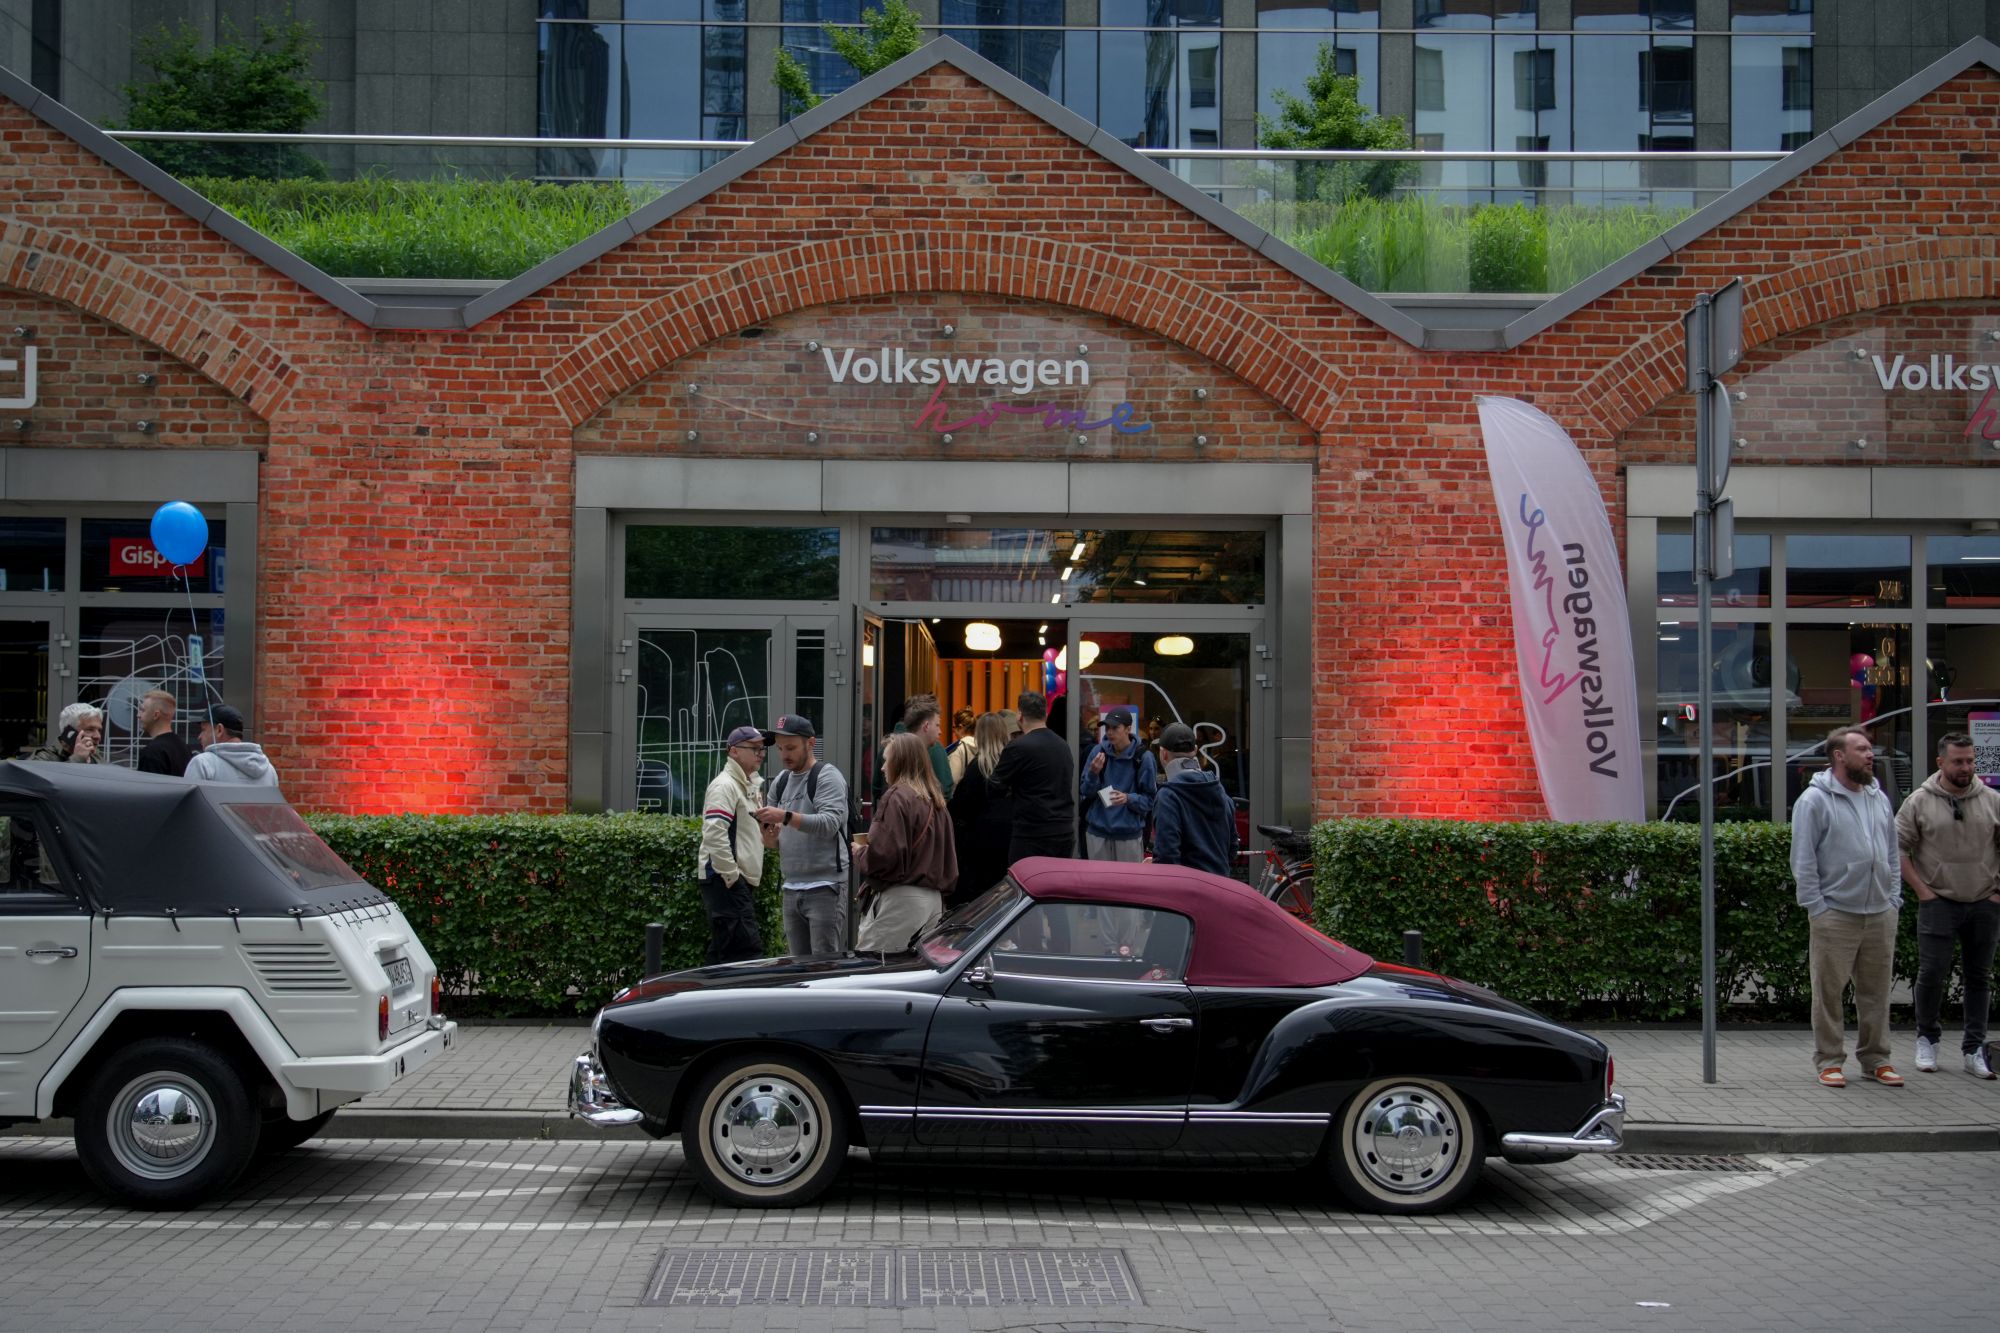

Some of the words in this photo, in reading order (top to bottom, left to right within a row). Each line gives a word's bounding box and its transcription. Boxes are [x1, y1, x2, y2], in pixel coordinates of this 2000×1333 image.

[822, 347, 1089, 394] Volkswagen
[1872, 354, 2000, 391] Volks
[912, 380, 1151, 435] home
[121, 545, 168, 569] Gisp
